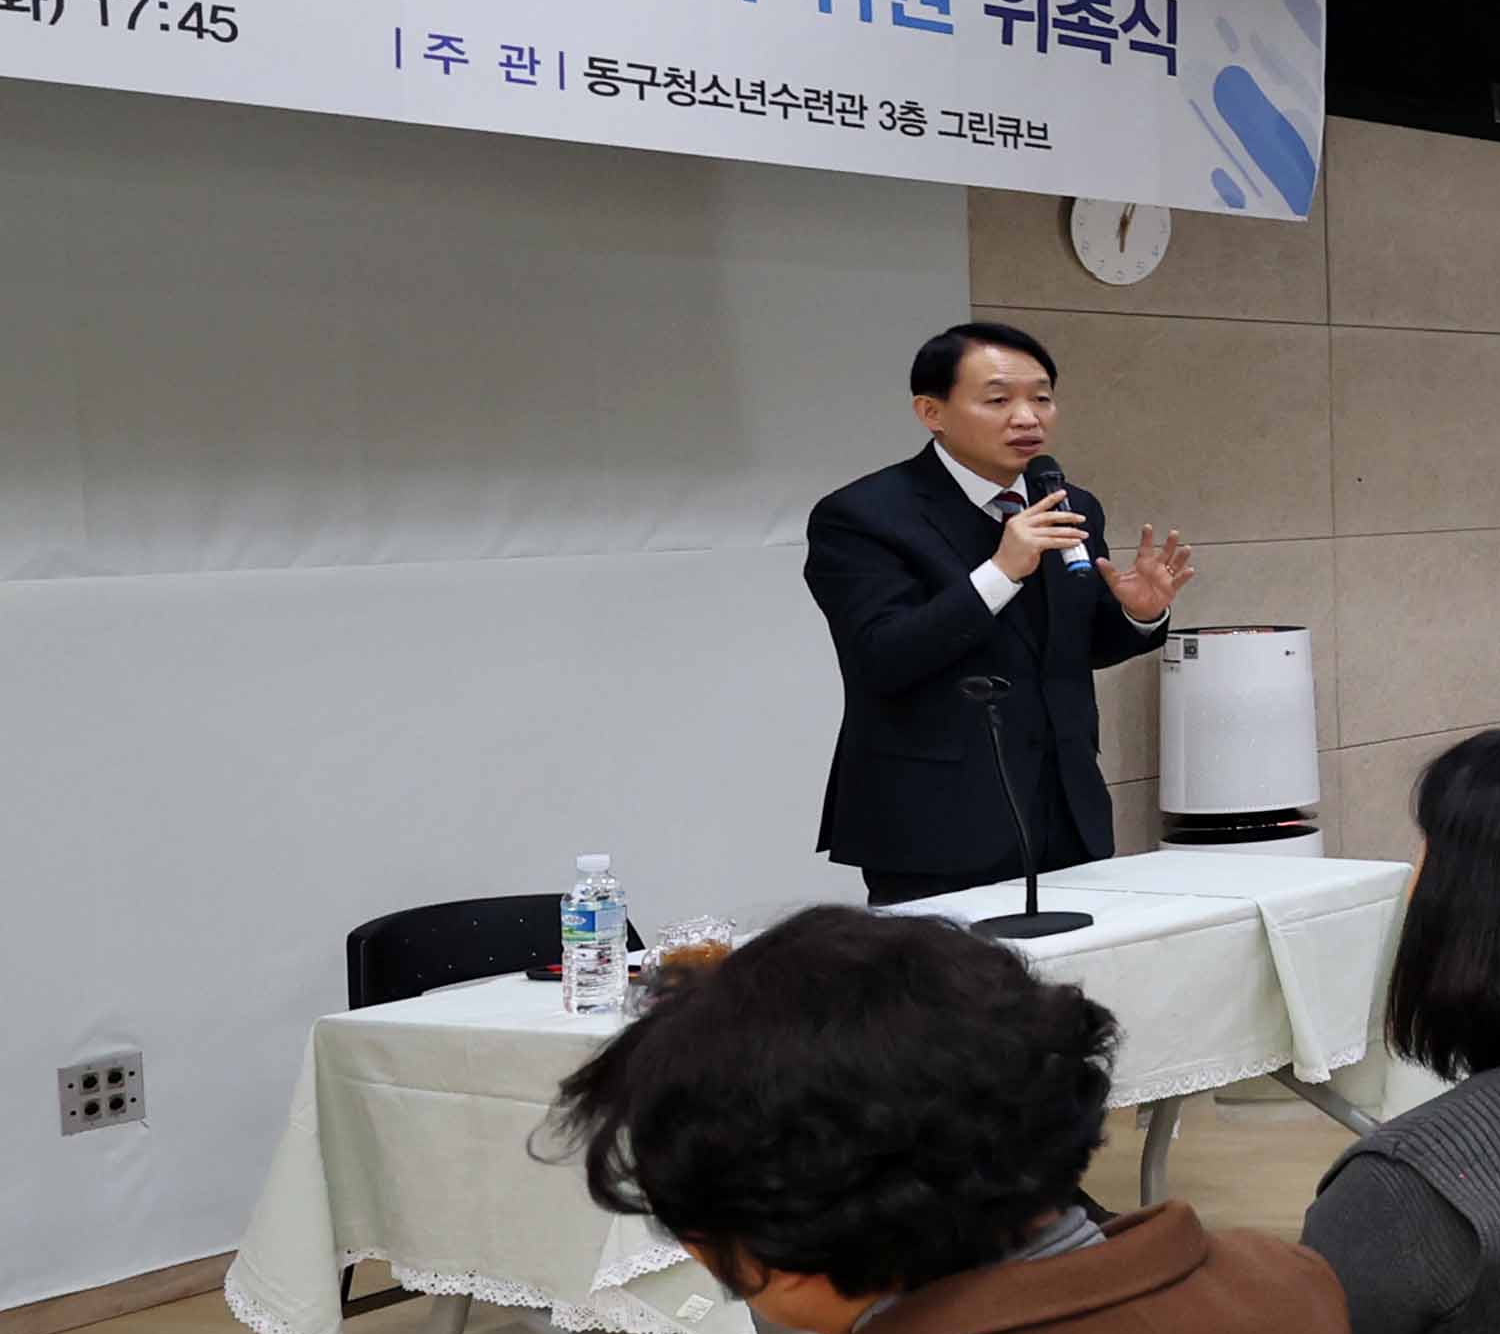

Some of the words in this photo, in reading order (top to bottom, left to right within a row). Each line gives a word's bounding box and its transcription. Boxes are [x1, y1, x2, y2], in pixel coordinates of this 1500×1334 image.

[584, 55, 868, 131] 동구청소년수련관
[878, 99, 928, 137] 3층
[937, 109, 1053, 151] 그린큐브
